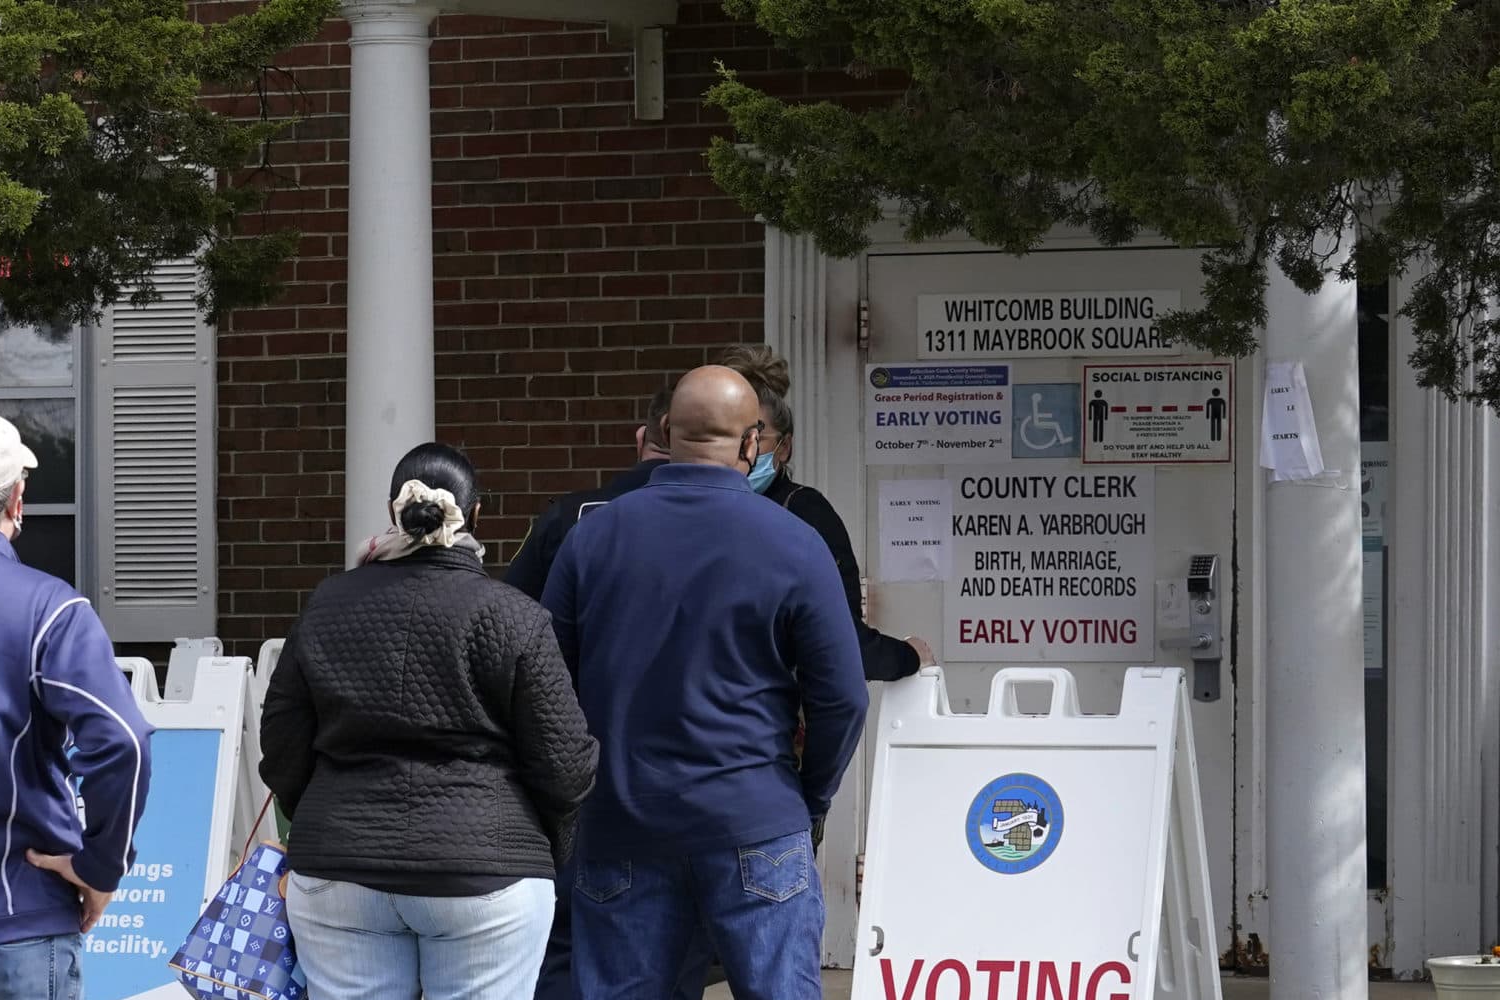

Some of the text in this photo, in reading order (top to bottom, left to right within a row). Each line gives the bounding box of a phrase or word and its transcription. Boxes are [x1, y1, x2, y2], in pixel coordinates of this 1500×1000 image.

[945, 297, 1154, 322] WHITCOMB BUILDING
[925, 329, 965, 352] 1311
[973, 327, 1085, 351] MAYBROOK
[1092, 371, 1223, 382] SOCIAL DISTANCING
[875, 392, 1003, 403] Grace Period Registration &
[876, 410, 1002, 426] EARLY VOTING
[876, 441, 914, 449] October
[936, 440, 986, 448] November
[961, 476, 1136, 499] COUNTY CLERK
[953, 513, 1146, 536] KAREN A. YARBROUGH
[975, 551, 1121, 573] BIRTH, MARRIAGE,
[960, 577, 1136, 596] AND DEATH RECORDS
[960, 619, 1137, 644] EARLY VOTING
[127, 863, 173, 882] ngs
[85, 934, 168, 959] facility.
